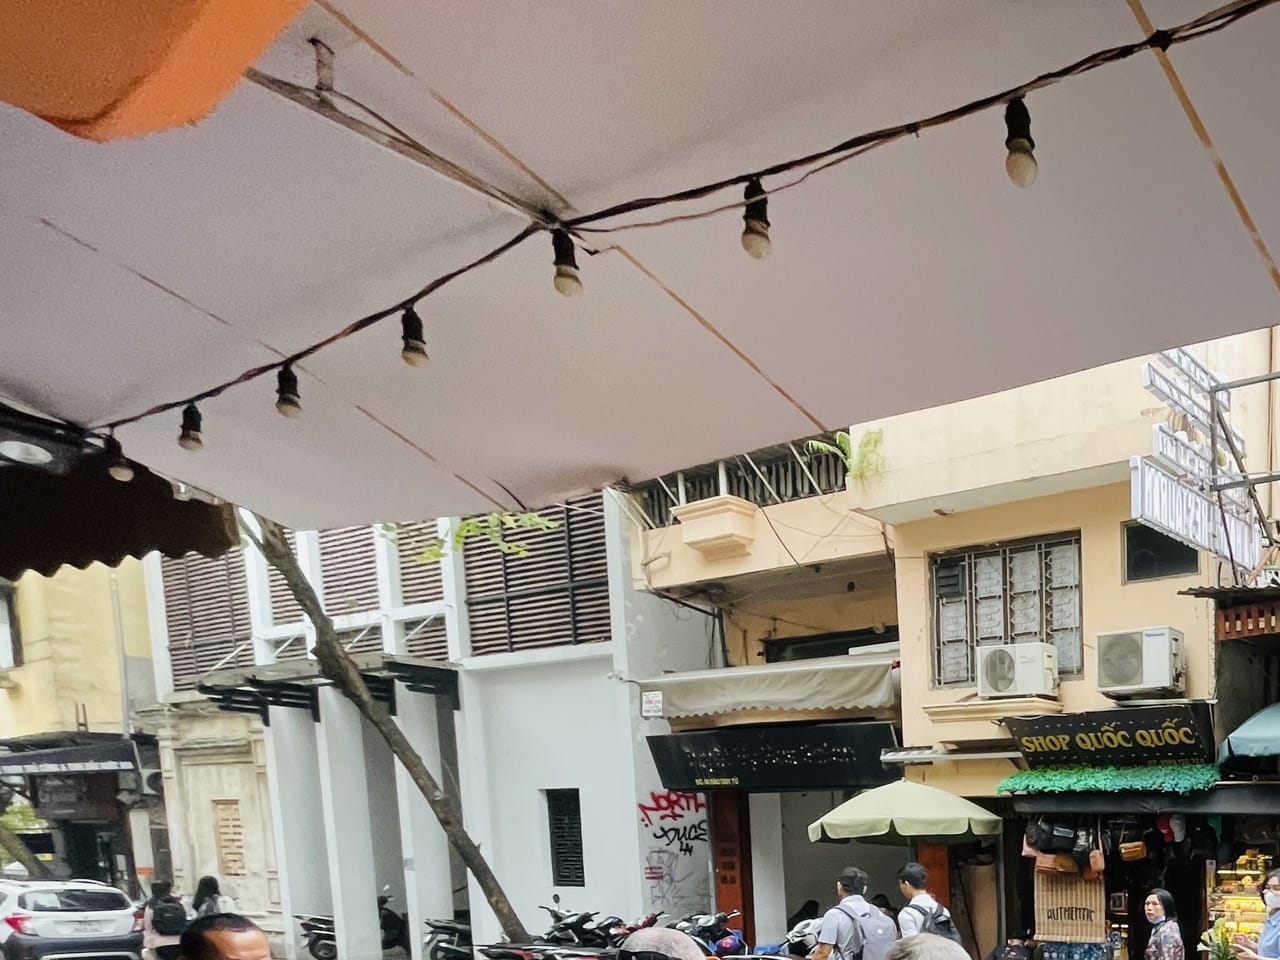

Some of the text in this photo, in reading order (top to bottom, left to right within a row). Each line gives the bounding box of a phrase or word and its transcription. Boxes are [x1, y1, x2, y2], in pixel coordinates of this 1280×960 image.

[1021, 718, 1196, 753] SHOP QUỐC QUỐC
